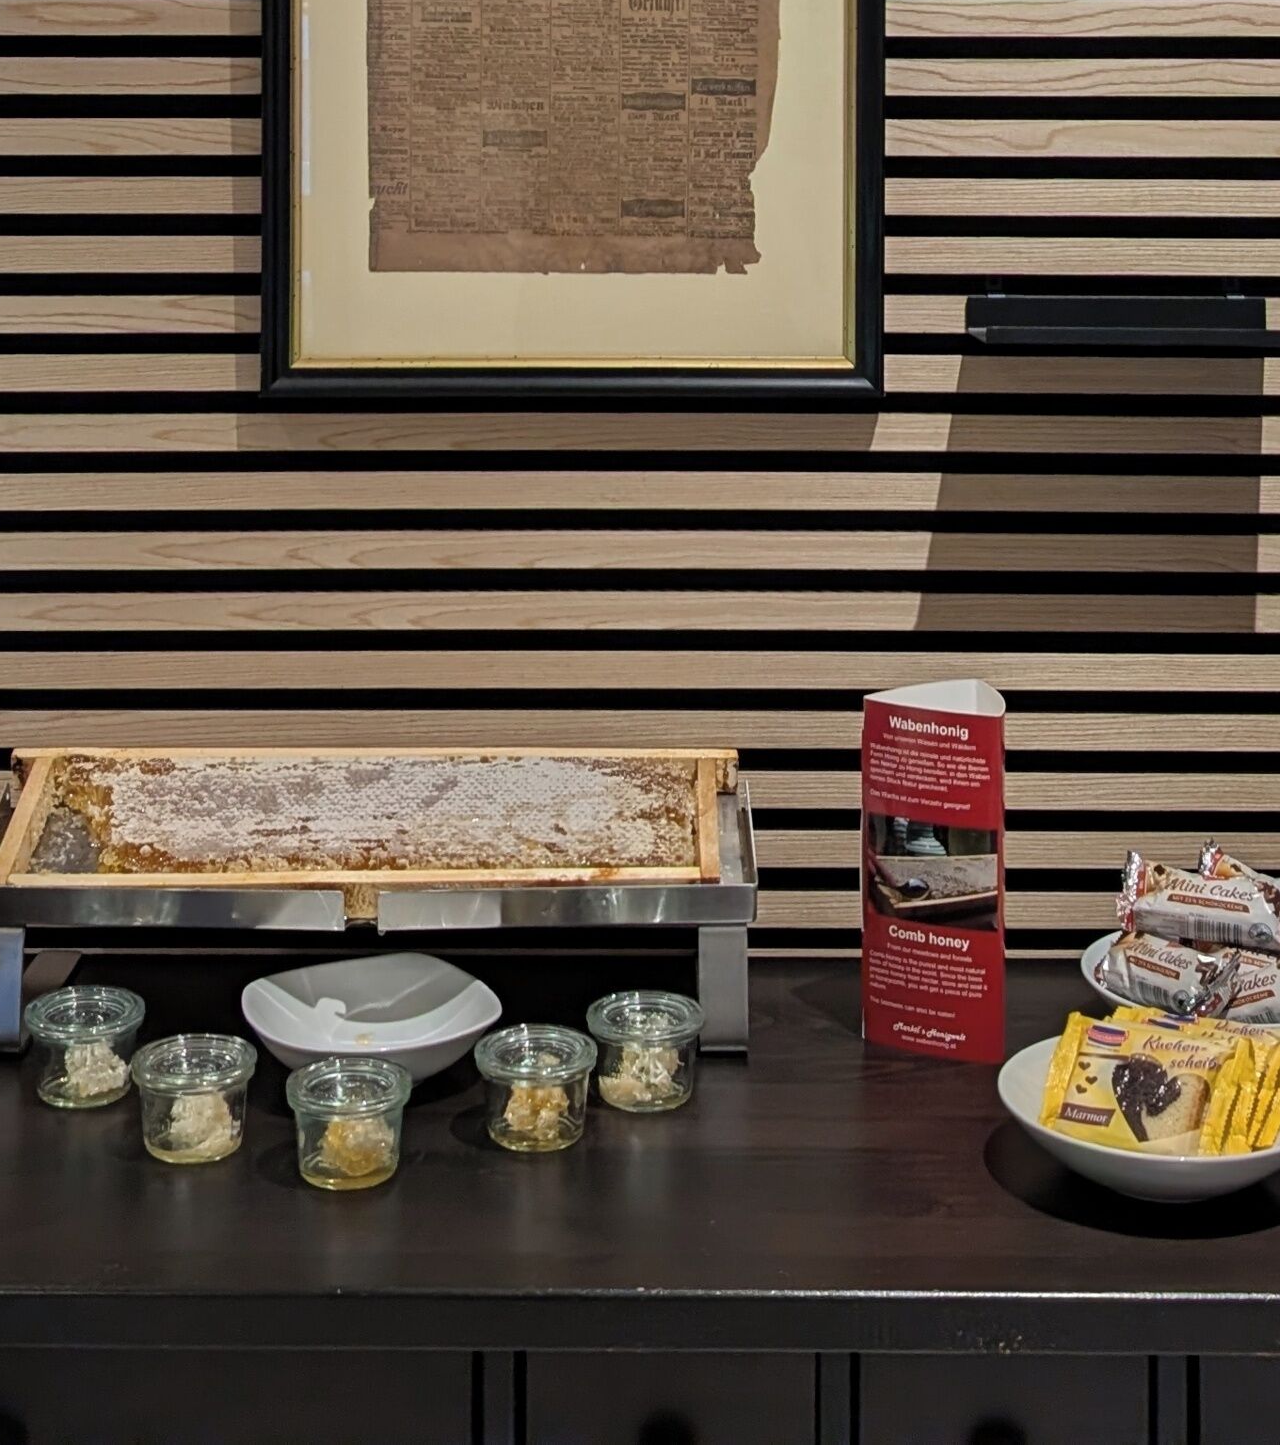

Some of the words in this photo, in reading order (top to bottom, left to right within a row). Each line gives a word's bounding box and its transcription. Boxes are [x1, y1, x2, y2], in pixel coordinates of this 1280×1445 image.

[889, 715, 969, 740] Wabenhonig
[1166, 874, 1207, 895] Mini
[1210, 884, 1256, 902] Cakes
[889, 925, 925, 943] Comb
[929, 932, 970, 952] honey
[1130, 940, 1158, 958] Mini
[1159, 949, 1192, 969] Cakes
[1142, 1035, 1207, 1054] Kuchen-
[1064, 1107, 1108, 1123] Marmor
